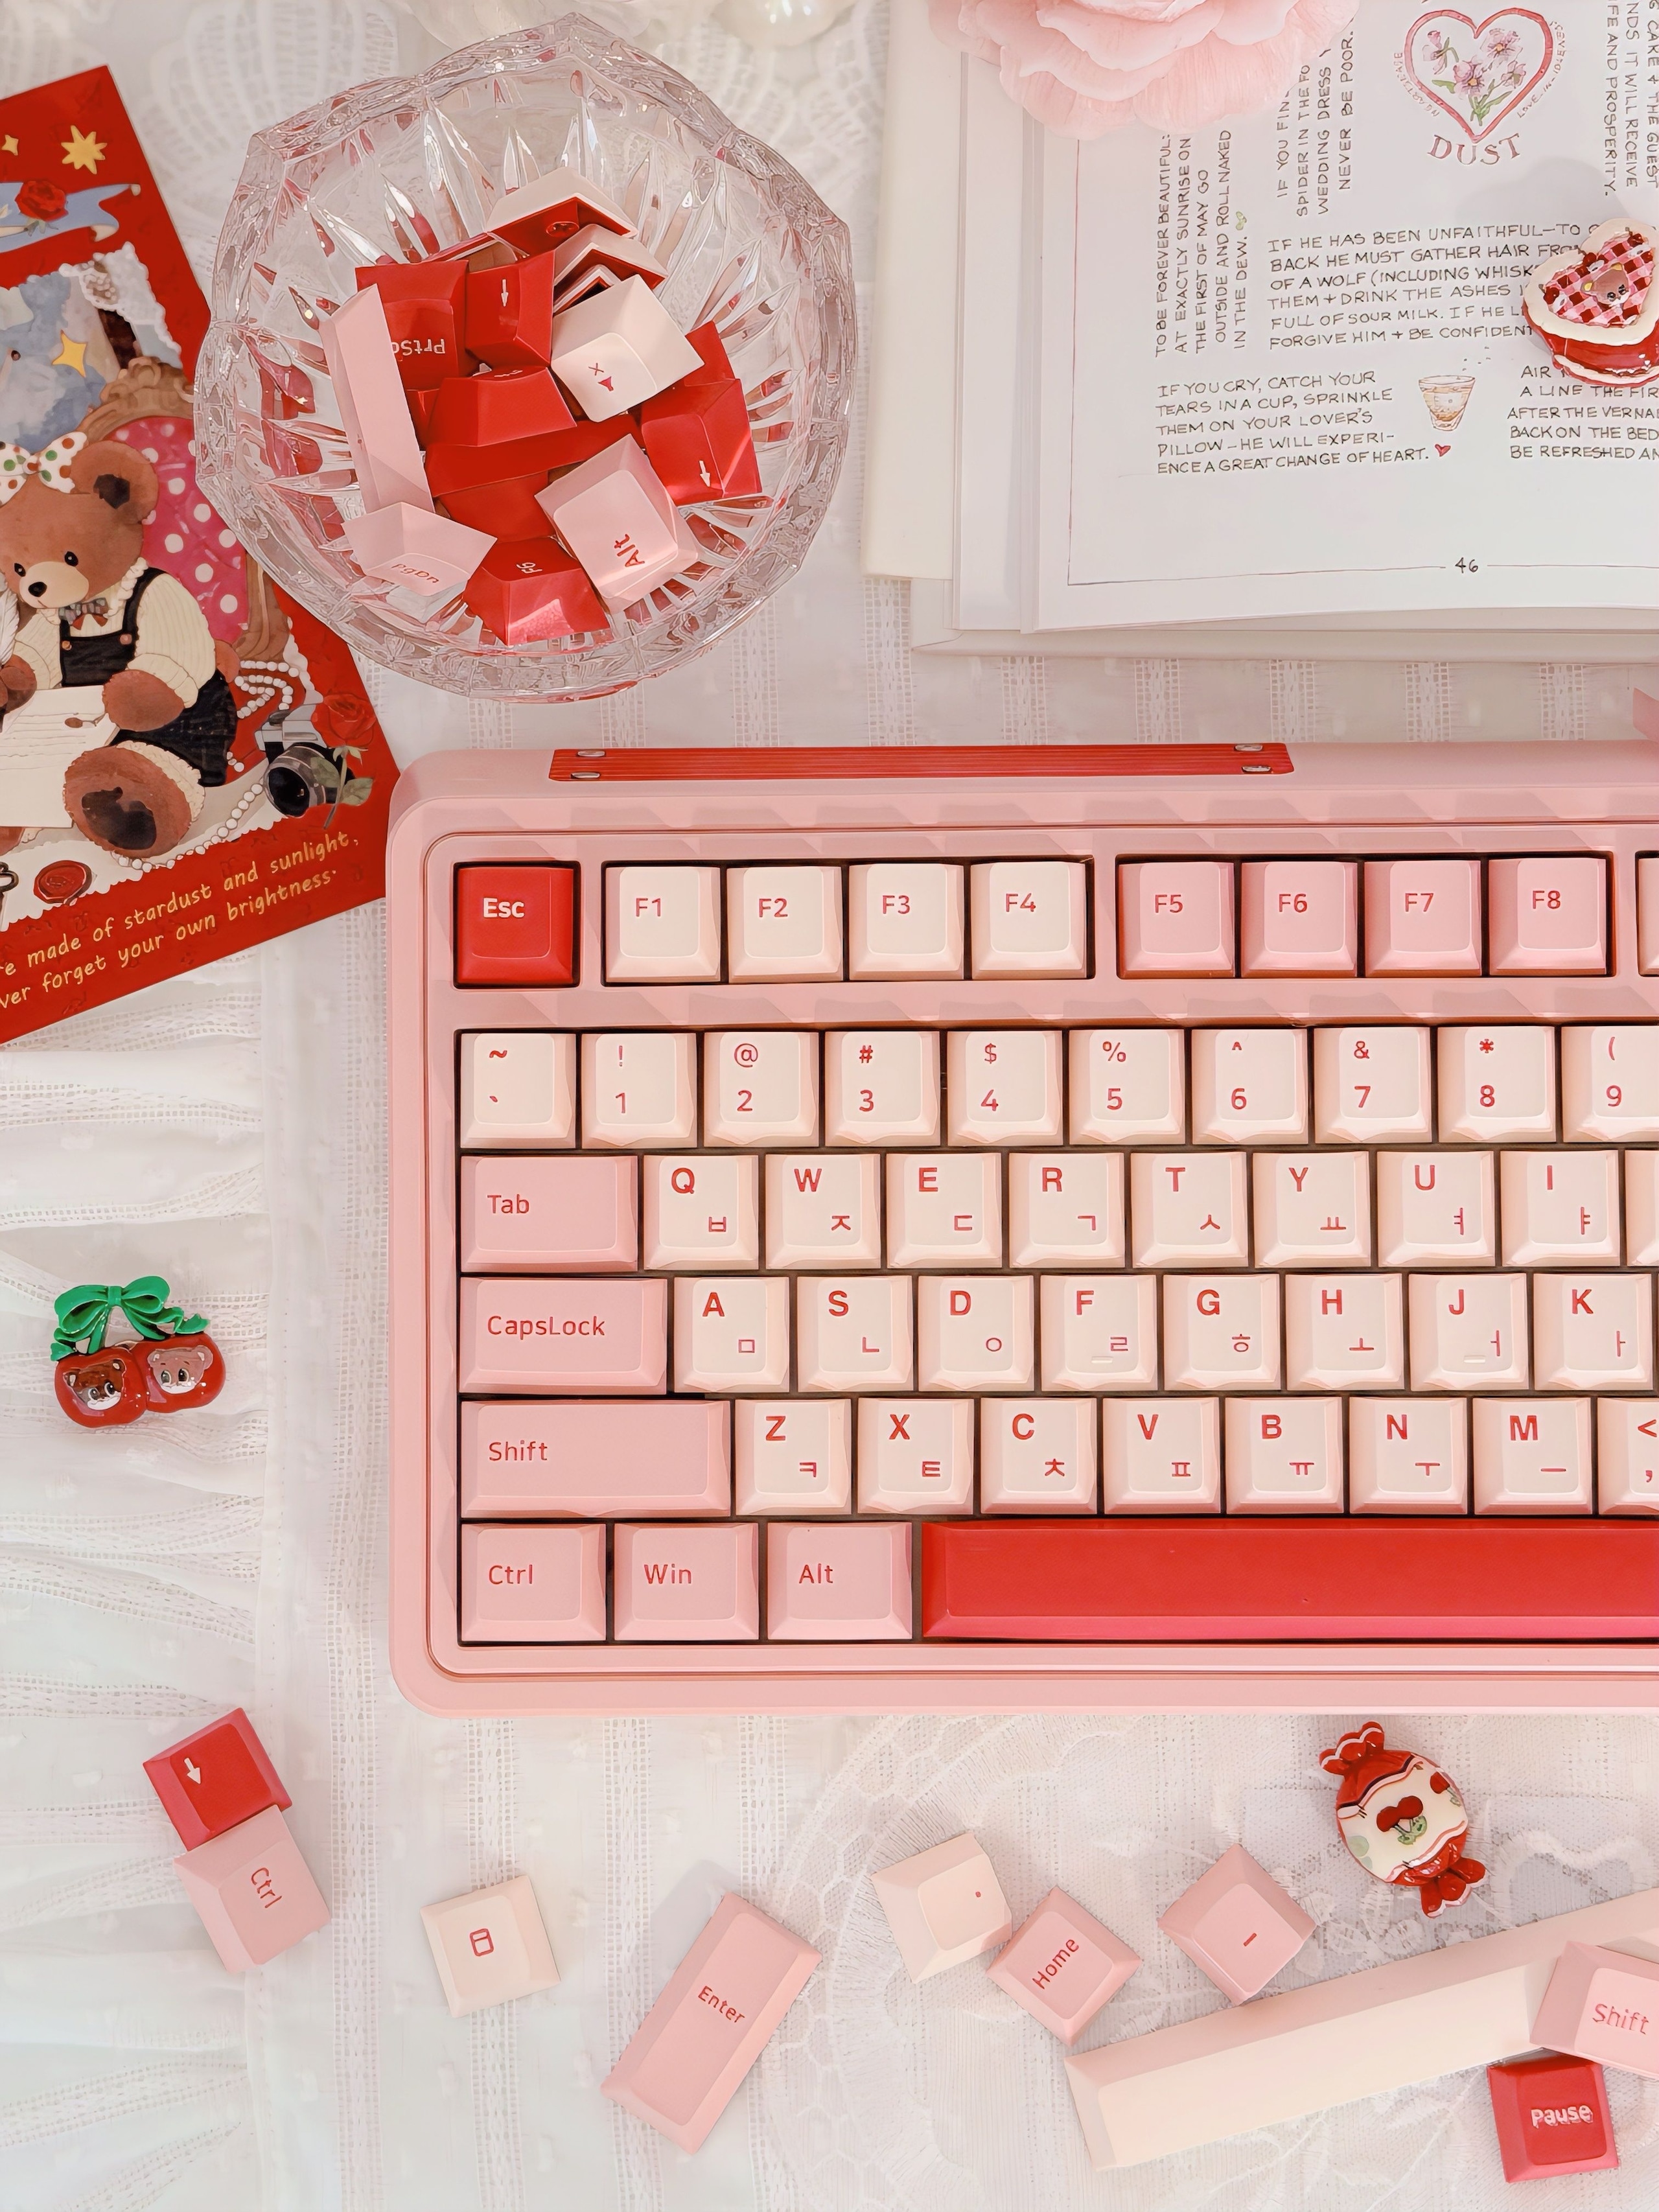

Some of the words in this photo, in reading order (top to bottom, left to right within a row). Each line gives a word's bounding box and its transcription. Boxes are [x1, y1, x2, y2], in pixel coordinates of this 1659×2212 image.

[1340, 30, 1354, 83] POOR.
[1607, 32, 1619, 71] AND
[1624, 52, 1639, 67] IT
[1297, 87, 1310, 121] THE
[1317, 67, 1332, 121] DRESS
[1341, 91, 1353, 117] BE
[1625, 73, 1638, 115] WILL
[1178, 137, 1191, 161] ON
[1297, 128, 1309, 146] IN
[1603, 76, 1618, 196] PROSPERITY.
[1217, 130, 1232, 183] NAKED
[1275, 139, 1290, 170] YOU
[1338, 128, 1352, 190] NEVER
[1427, 134, 1520, 166] DUST
[1625, 119, 1639, 187] RECEIVE
[1197, 169, 1209, 194] GO
[1296, 152, 1309, 217] SPIDER
[1317, 130, 1330, 215] WEDDING
[1277, 179, 1288, 198] IF
[1176, 165, 1190, 240] SUNRISE
[1216, 185, 1229, 227] ROLL
[1196, 202, 1209, 237] MAY
[1196, 242, 1207, 265] OF
[1216, 233, 1229, 268] AND
[1267, 239, 1292, 253] IF
[1300, 236, 1323, 249] HE
[1329, 233, 1365, 247] HAS
[1373, 229, 1421, 245] BEEN
[1156, 227, 1169, 303] FOREVER
[1235, 236, 1248, 281] DEW.
[1270, 255, 1319, 272] BACK
[1326, 253, 1350, 268] HE
[1354, 250, 1405, 264] MUST
[1410, 245, 1481, 262] GATHER
[1488, 244, 1529, 258] HAIR
[1175, 247, 1189, 321] EXACTLY
[1195, 269, 1208, 316] FIRST
[1270, 277, 1295, 290] OF
[1299, 276, 1312, 289] A
[1316, 272, 1366, 287] WOLF
[1214, 275, 1228, 343] OUTSIDE
[1234, 287, 1246, 326] THE
[1267, 295, 1319, 310] THEM
[1341, 289, 1397, 305] DRINK
[1402, 286, 1442, 301] THE
[1450, 284, 1511, 297] ASHES
[1155, 309, 1167, 331] BE
[1271, 314, 1315, 330] FULL
[1319, 312, 1344, 327] OF
[1348, 312, 1391, 325] SOUR
[1398, 309, 1444, 320] MILK.
[1449, 305, 1475, 319] IF
[1481, 306, 1505, 318] HE
[1155, 334, 1167, 358] TO
[1174, 331, 1188, 353] AT
[1195, 320, 1207, 355] THE
[1234, 331, 1246, 349] IN
[1270, 332, 1347, 350] FORGIVE
[1352, 331, 1386, 343] HIM
[1409, 328, 1433, 340] BE
[1157, 384, 1180, 398] IF
[1183, 382, 1220, 395] YOU
[1223, 377, 1262, 393] CRY,
[1268, 375, 1322, 390] CATCH
[1328, 371, 1376, 386] YOUR
[1520, 365, 1552, 378] AIR
[1155, 401, 1212, 417] TEARS
[1219, 399, 1237, 412] IN
[1240, 399, 1251, 411] A
[1257, 395, 1297, 410] CUP,
[1303, 388, 1393, 405] SPRINKLE
[1519, 386, 1533, 397] A
[1539, 384, 1583, 397] LINE
[1590, 386, 1623, 398] THE
[1155, 421, 1204, 436] THEM
[1209, 419, 1235, 432] ON
[1242, 415, 1291, 430] YOUR
[1299, 407, 1373, 426] LOVER'S
[1507, 406, 1561, 419] AFTER
[1562, 406, 1597, 419] THE
[1269, 436, 1313, 449] WILL
[1510, 425, 1553, 439] BACK
[1555, 425, 1581, 438] ON
[1587, 426, 1621, 439] THE
[1157, 461, 1201, 474] ENCE
[1203, 461, 1216, 474] A
[1218, 457, 1273, 472] GREAT
[1275, 452, 1341, 467] CHANGE
[1347, 450, 1370, 463] OF
[1373, 447, 1429, 463] HEART.
[1510, 445, 1533, 459] BE
[1540, 445, 1635, 459] REFRESHED
[614, 533, 645, 568] Alt
[1454, 557, 1479, 574] 46
[483, 897, 525, 918] Esc
[636, 898, 661, 917] F1
[758, 898, 788, 918] F2
[882, 894, 911, 914] F3
[1006, 892, 1036, 913] F4
[1155, 894, 1183, 913] F5
[1279, 893, 1308, 913] F6
[1405, 892, 1434, 913] F7
[1532, 890, 1561, 910] F8
[27, 933, 82, 968] made
[93, 916, 115, 942] of
[124, 884, 213, 930] stardust
[224, 860, 259, 891] and
[41, 955, 106, 993] forget
[118, 935, 164, 968] your
[176, 914, 216, 940] own
[671, 1167, 695, 1194] Q
[794, 1168, 822, 1193] W
[918, 1167, 938, 1193] E
[1041, 1167, 1063, 1193] R
[1165, 1167, 1186, 1193] T
[1288, 1167, 1309, 1193] Y
[1414, 1165, 1435, 1191] U
[487, 1193, 529, 1214] Tab
[702, 1292, 725, 1317] A
[828, 1290, 849, 1317] S
[950, 1290, 971, 1316] D
[1076, 1290, 1095, 1316] F
[1196, 1288, 1220, 1316] G
[1321, 1289, 1343, 1315] H
[1448, 1288, 1465, 1316] J
[1572, 1288, 1594, 1314] K
[487, 1315, 605, 1340] CapsLock
[765, 1415, 786, 1441] Z
[888, 1414, 911, 1440] X
[1012, 1413, 1035, 1440] C
[1137, 1414, 1159, 1440] V
[1261, 1414, 1282, 1439] B
[1386, 1414, 1408, 1440] N
[1509, 1415, 1538, 1441] M
[489, 1439, 548, 1461] Shift
[489, 1564, 533, 1585] Ctrl
[644, 1563, 691, 1585] Win
[798, 1563, 833, 1584] Alt
[251, 1867, 283, 1909] Ctrl
[1032, 1939, 1080, 1990] Home
[697, 1985, 745, 2023] Enter
[1592, 2003, 1649, 2035] Shift
[1531, 2104, 1594, 2128] Pause
